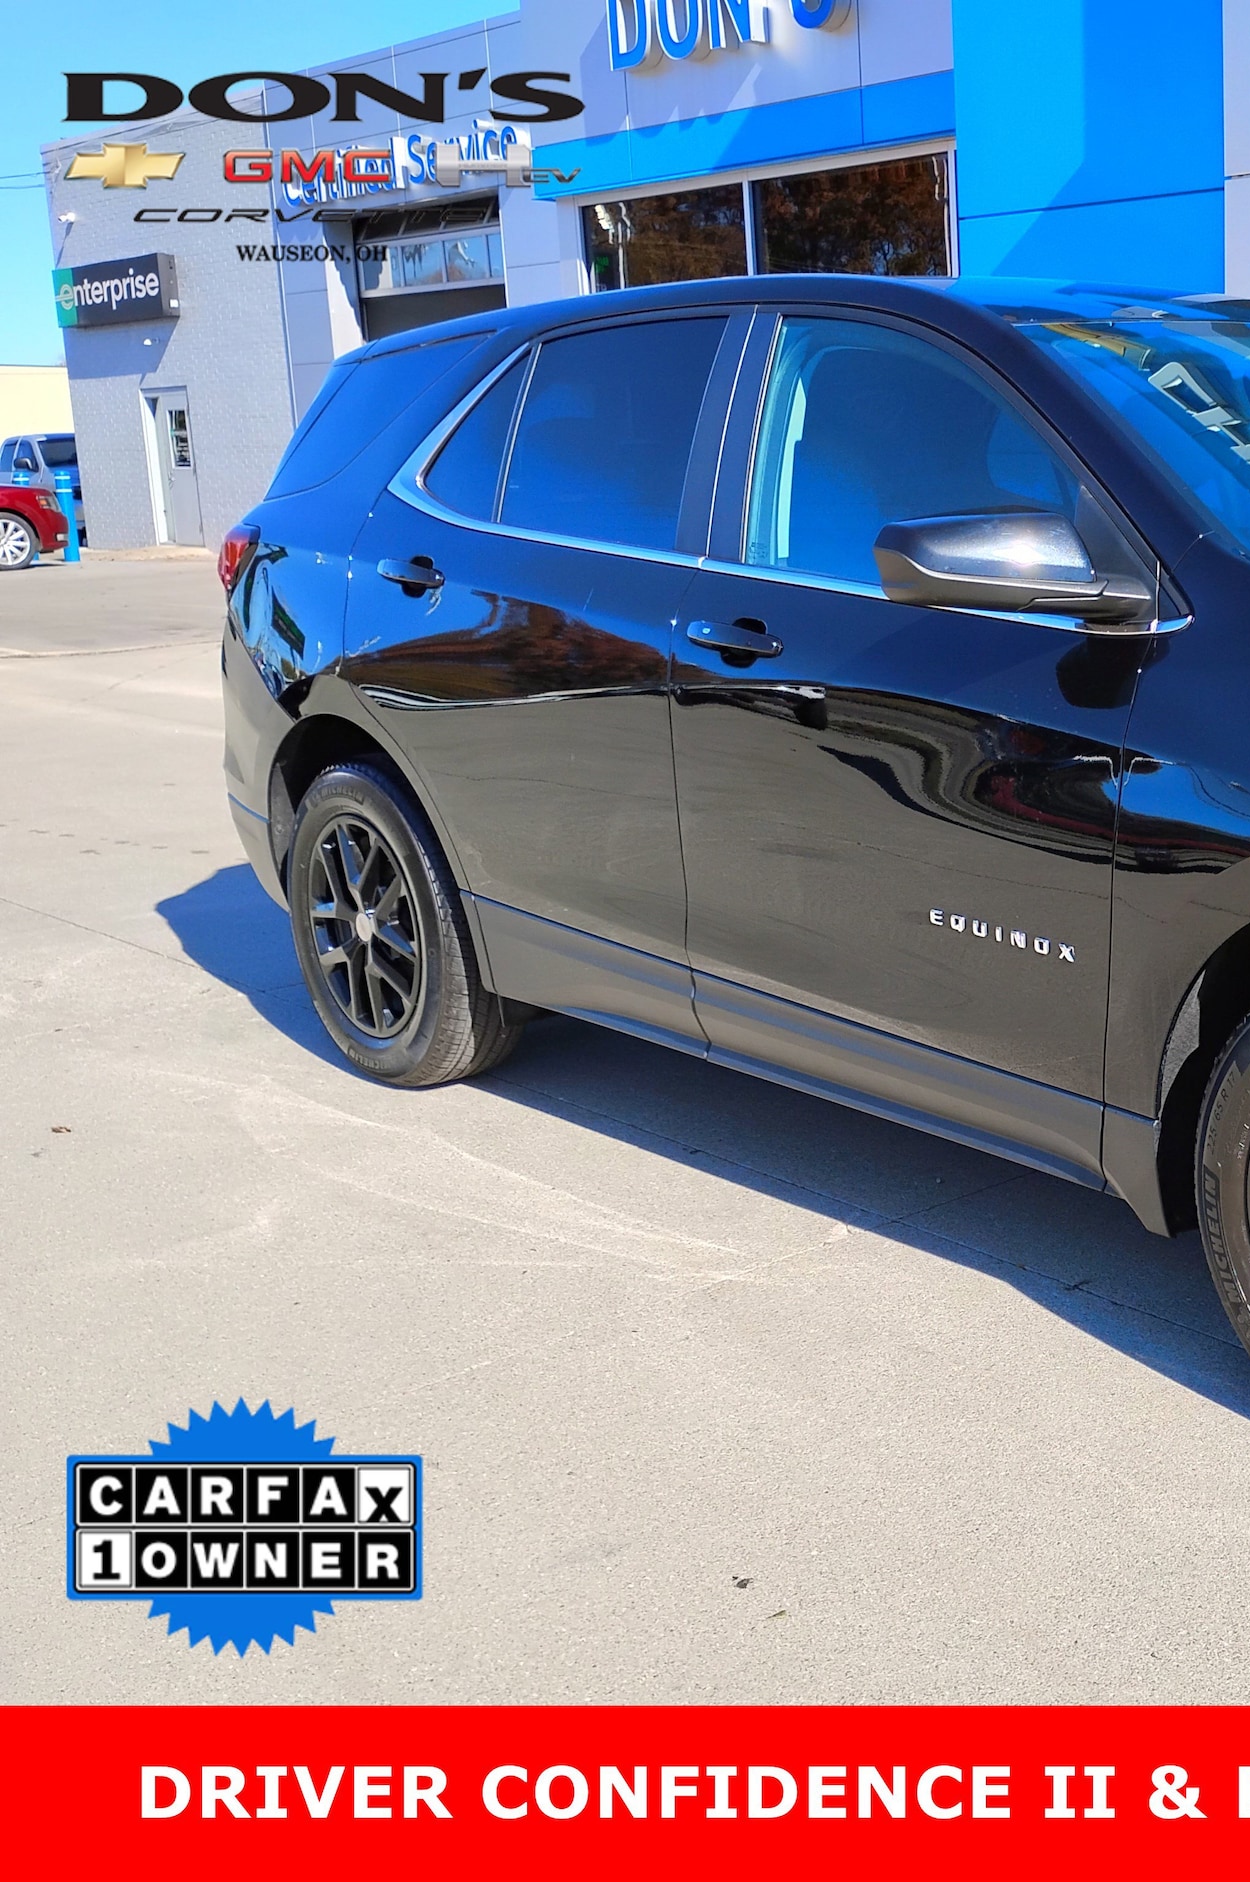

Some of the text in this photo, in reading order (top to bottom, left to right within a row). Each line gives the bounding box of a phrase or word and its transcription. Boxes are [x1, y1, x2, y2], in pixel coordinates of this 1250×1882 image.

[56, 267, 160, 311] enterprise
[929, 908, 1076, 963] EQUINOX
[1203, 1172, 1242, 1304] MICHELIN
